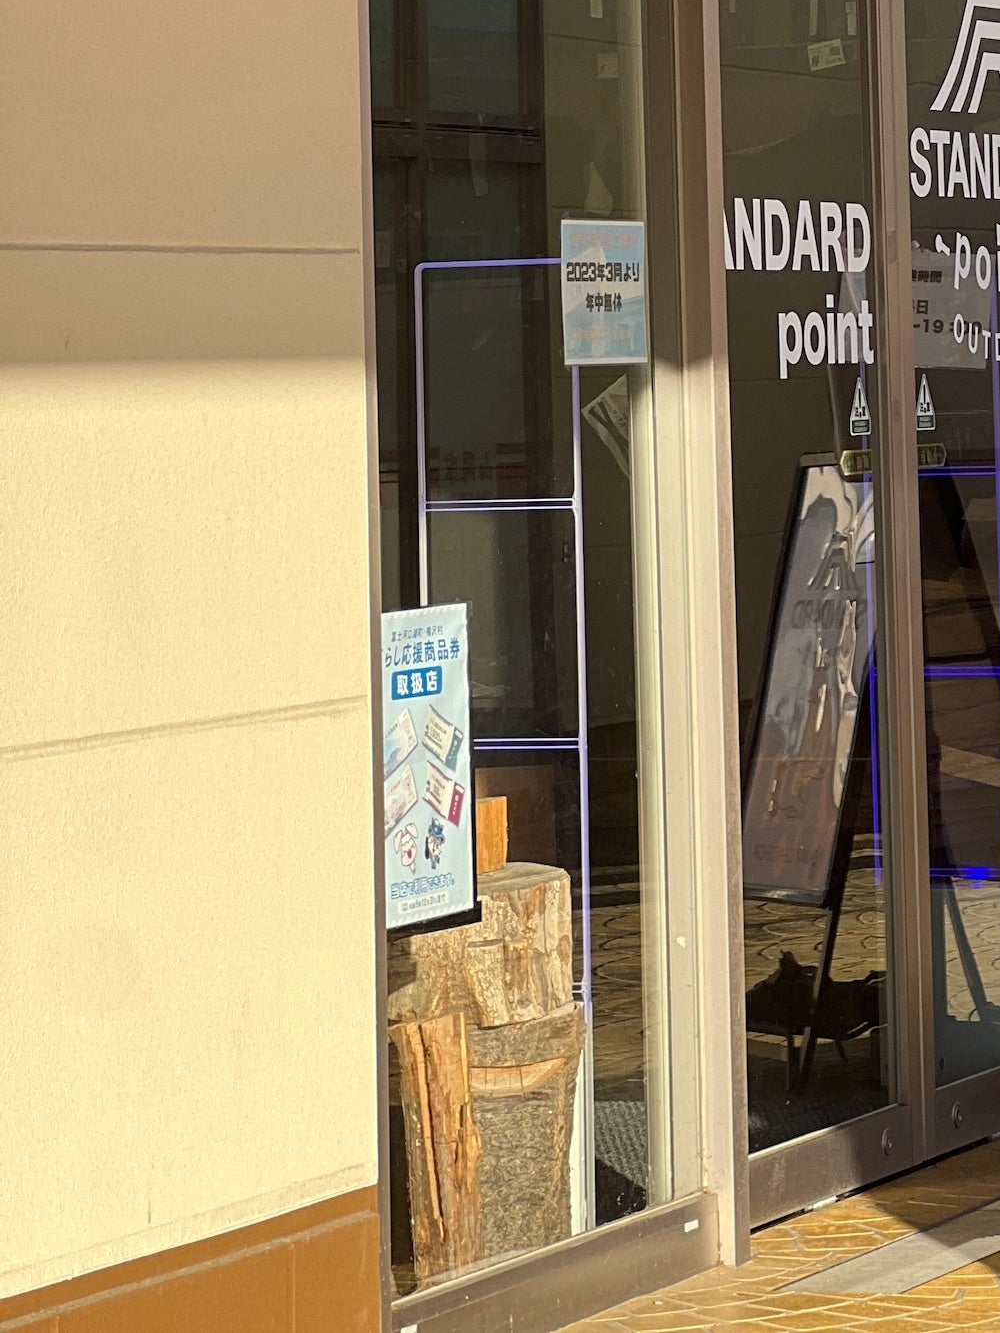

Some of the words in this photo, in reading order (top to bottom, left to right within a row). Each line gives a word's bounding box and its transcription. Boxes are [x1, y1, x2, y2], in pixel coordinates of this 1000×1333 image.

[566, 262, 640, 282] 2023年3月より
[585, 292, 623, 313] 年中無休
[778, 294, 875, 379] point
[396, 670, 439, 696] 取扱店
